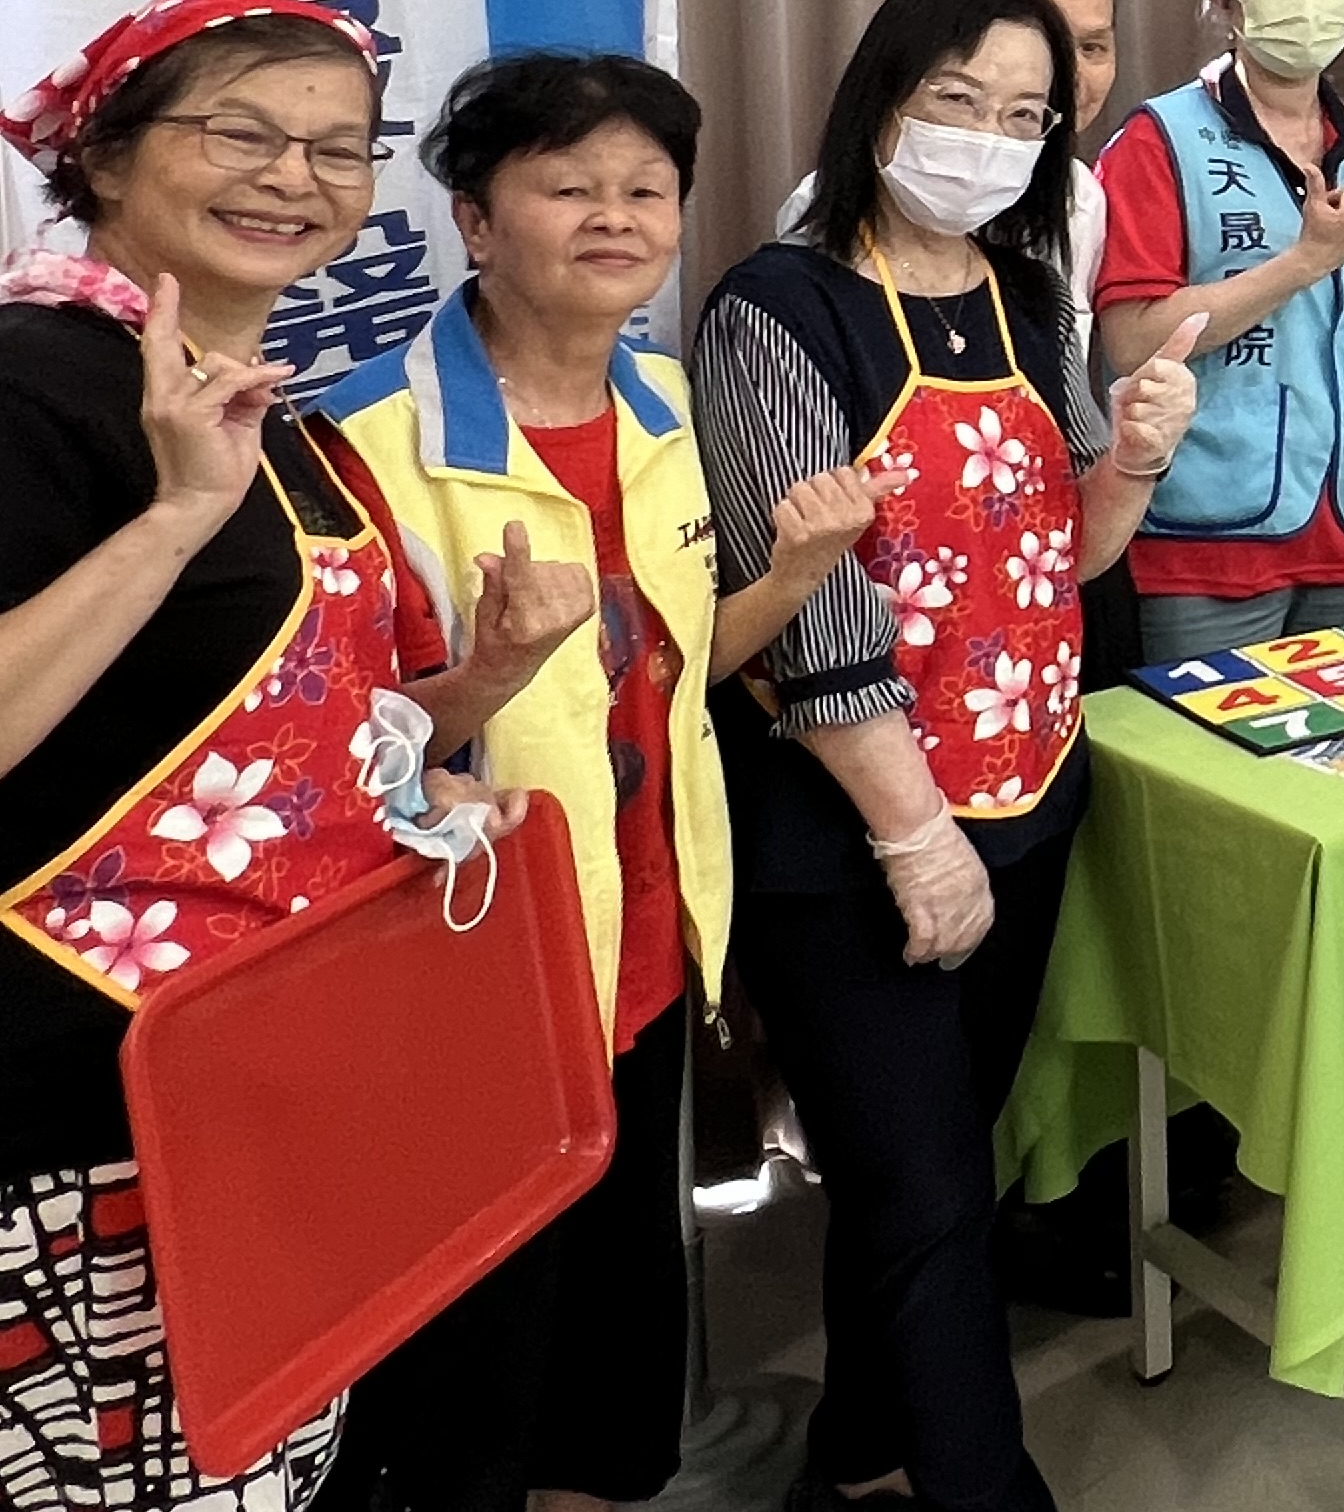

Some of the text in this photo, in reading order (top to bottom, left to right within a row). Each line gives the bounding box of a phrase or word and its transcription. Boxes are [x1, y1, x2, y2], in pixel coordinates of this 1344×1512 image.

[1207, 157, 1275, 367] 天晟院
[1168, 660, 1226, 685] 1
[1268, 639, 1340, 664] 2
[1216, 686, 1280, 711] 4
[1251, 709, 1315, 739] 7
